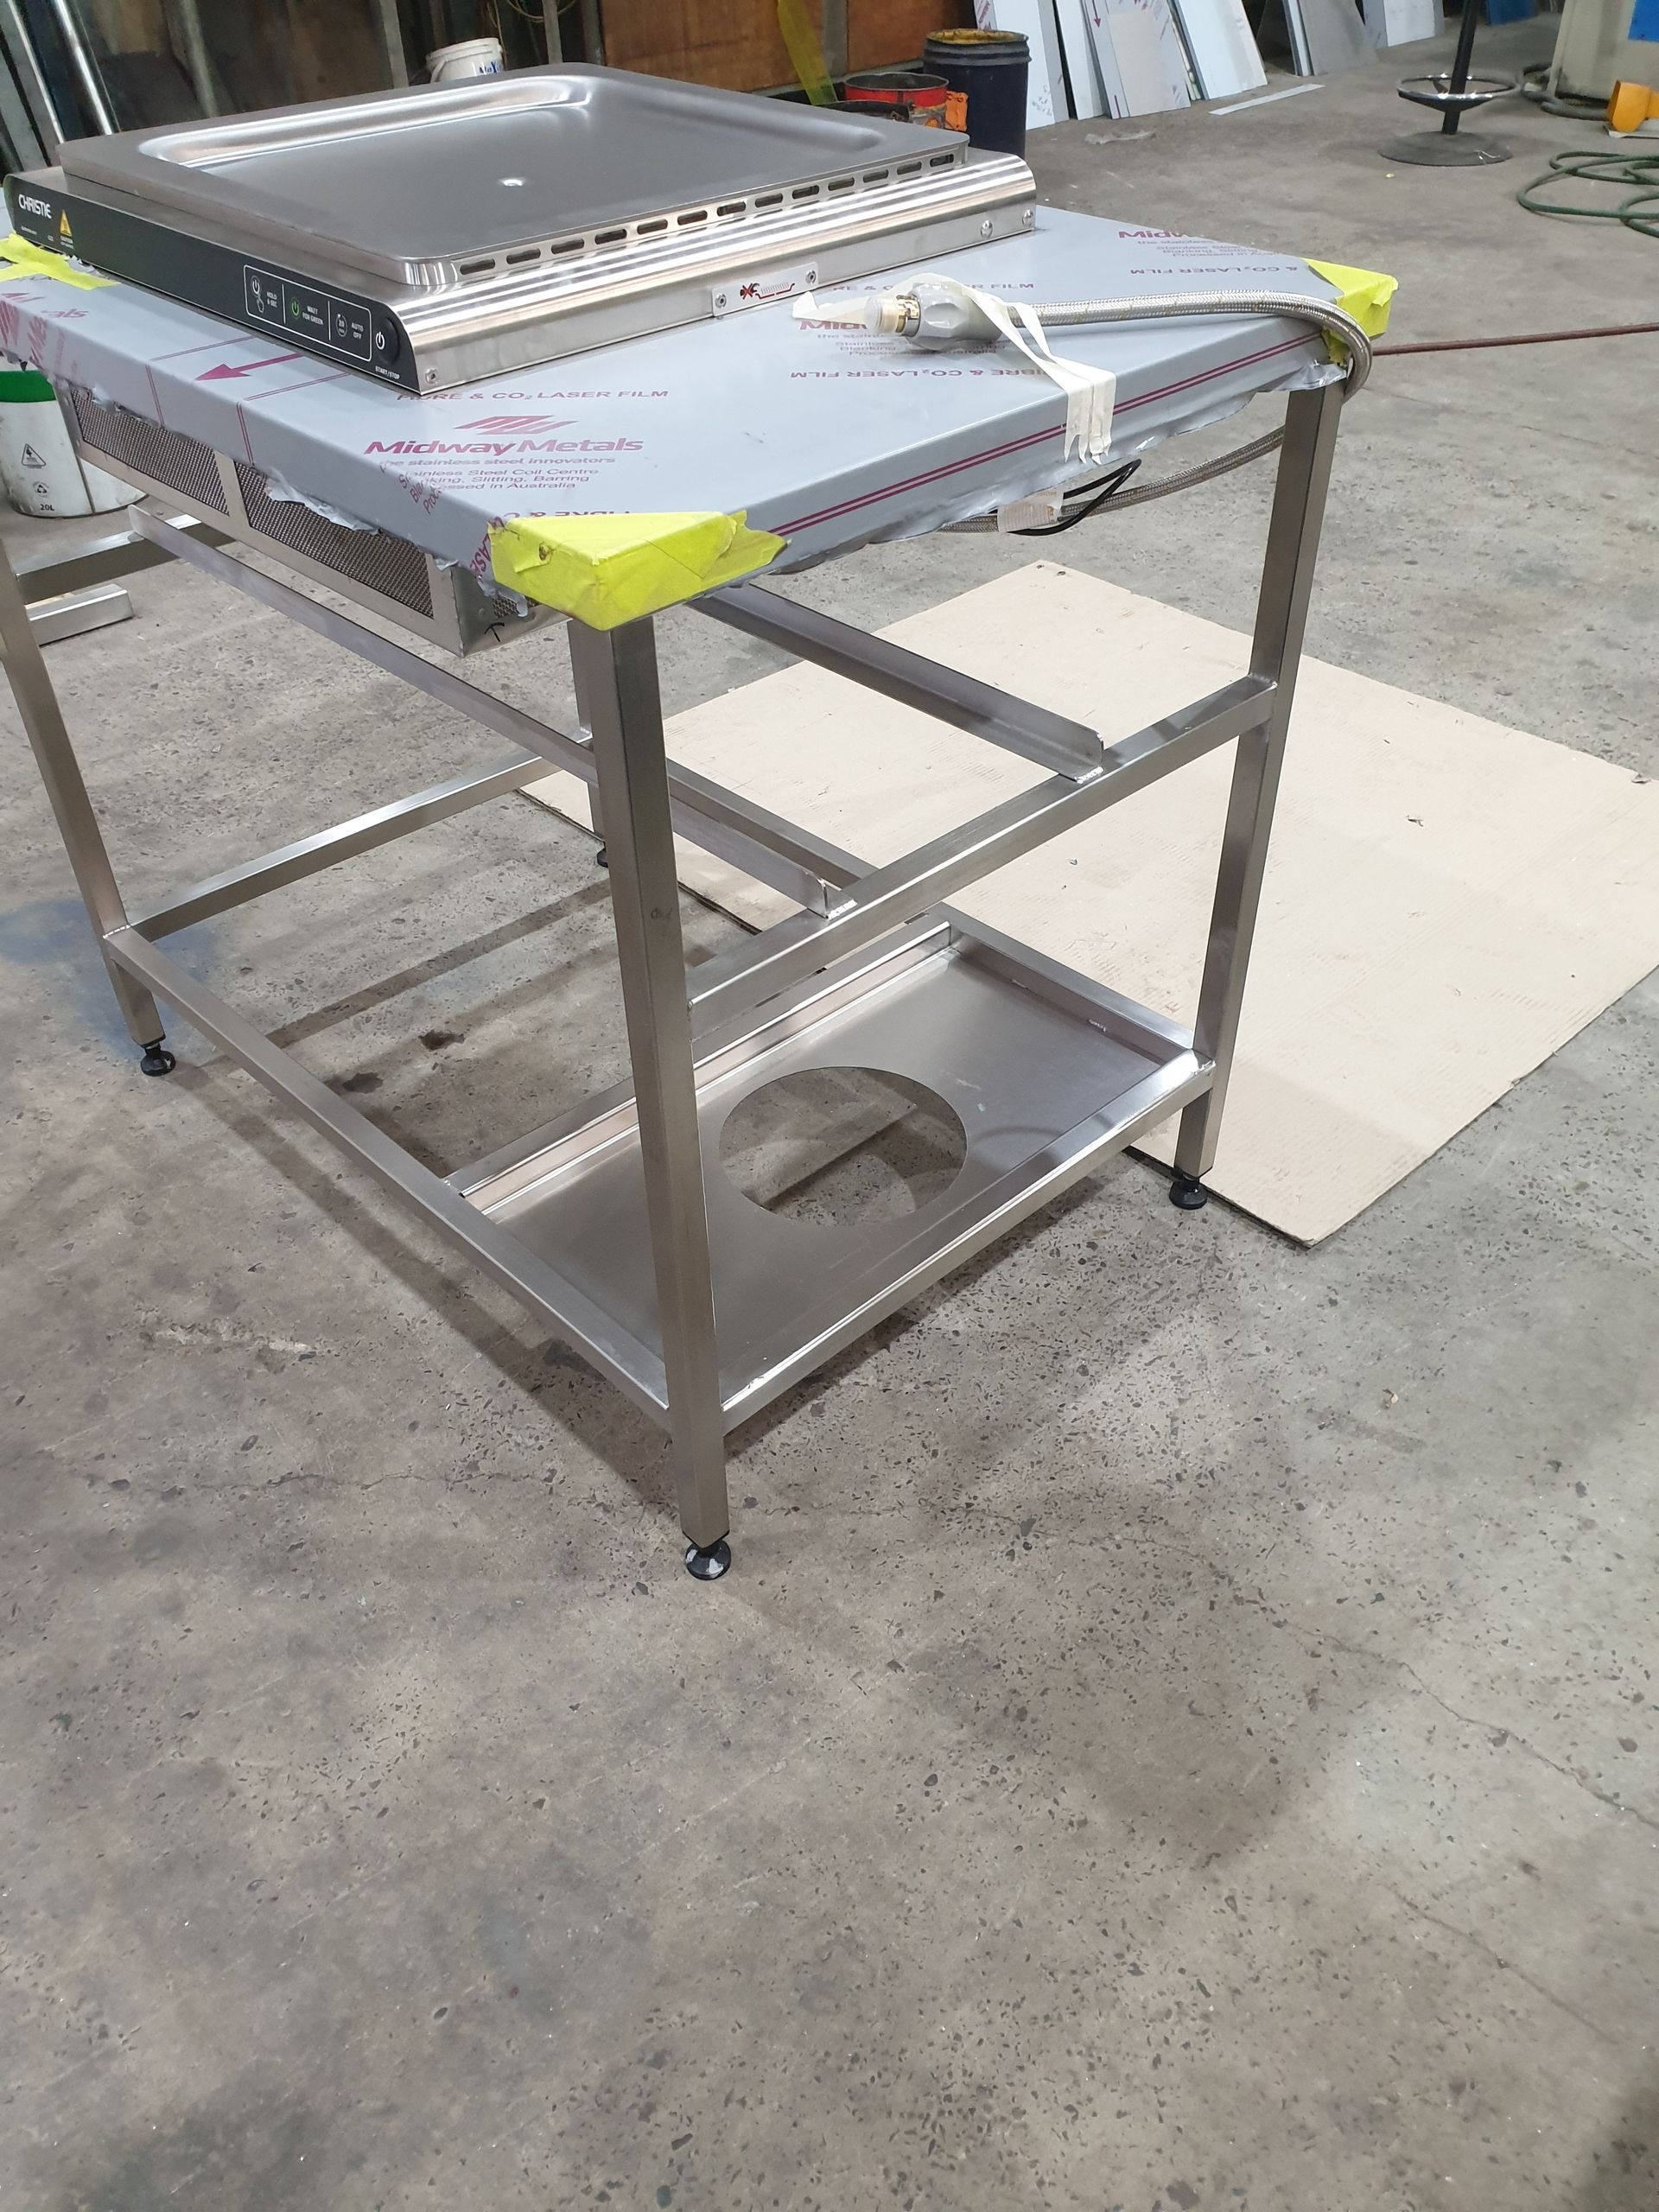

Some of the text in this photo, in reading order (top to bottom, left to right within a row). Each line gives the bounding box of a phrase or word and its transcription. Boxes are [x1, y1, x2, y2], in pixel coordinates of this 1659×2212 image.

[18, 194, 52, 219] CHRISTIE
[351, 322, 364, 332] AUTO
[353, 331, 362, 340] OFF
[375, 365, 400, 380] START/STOP
